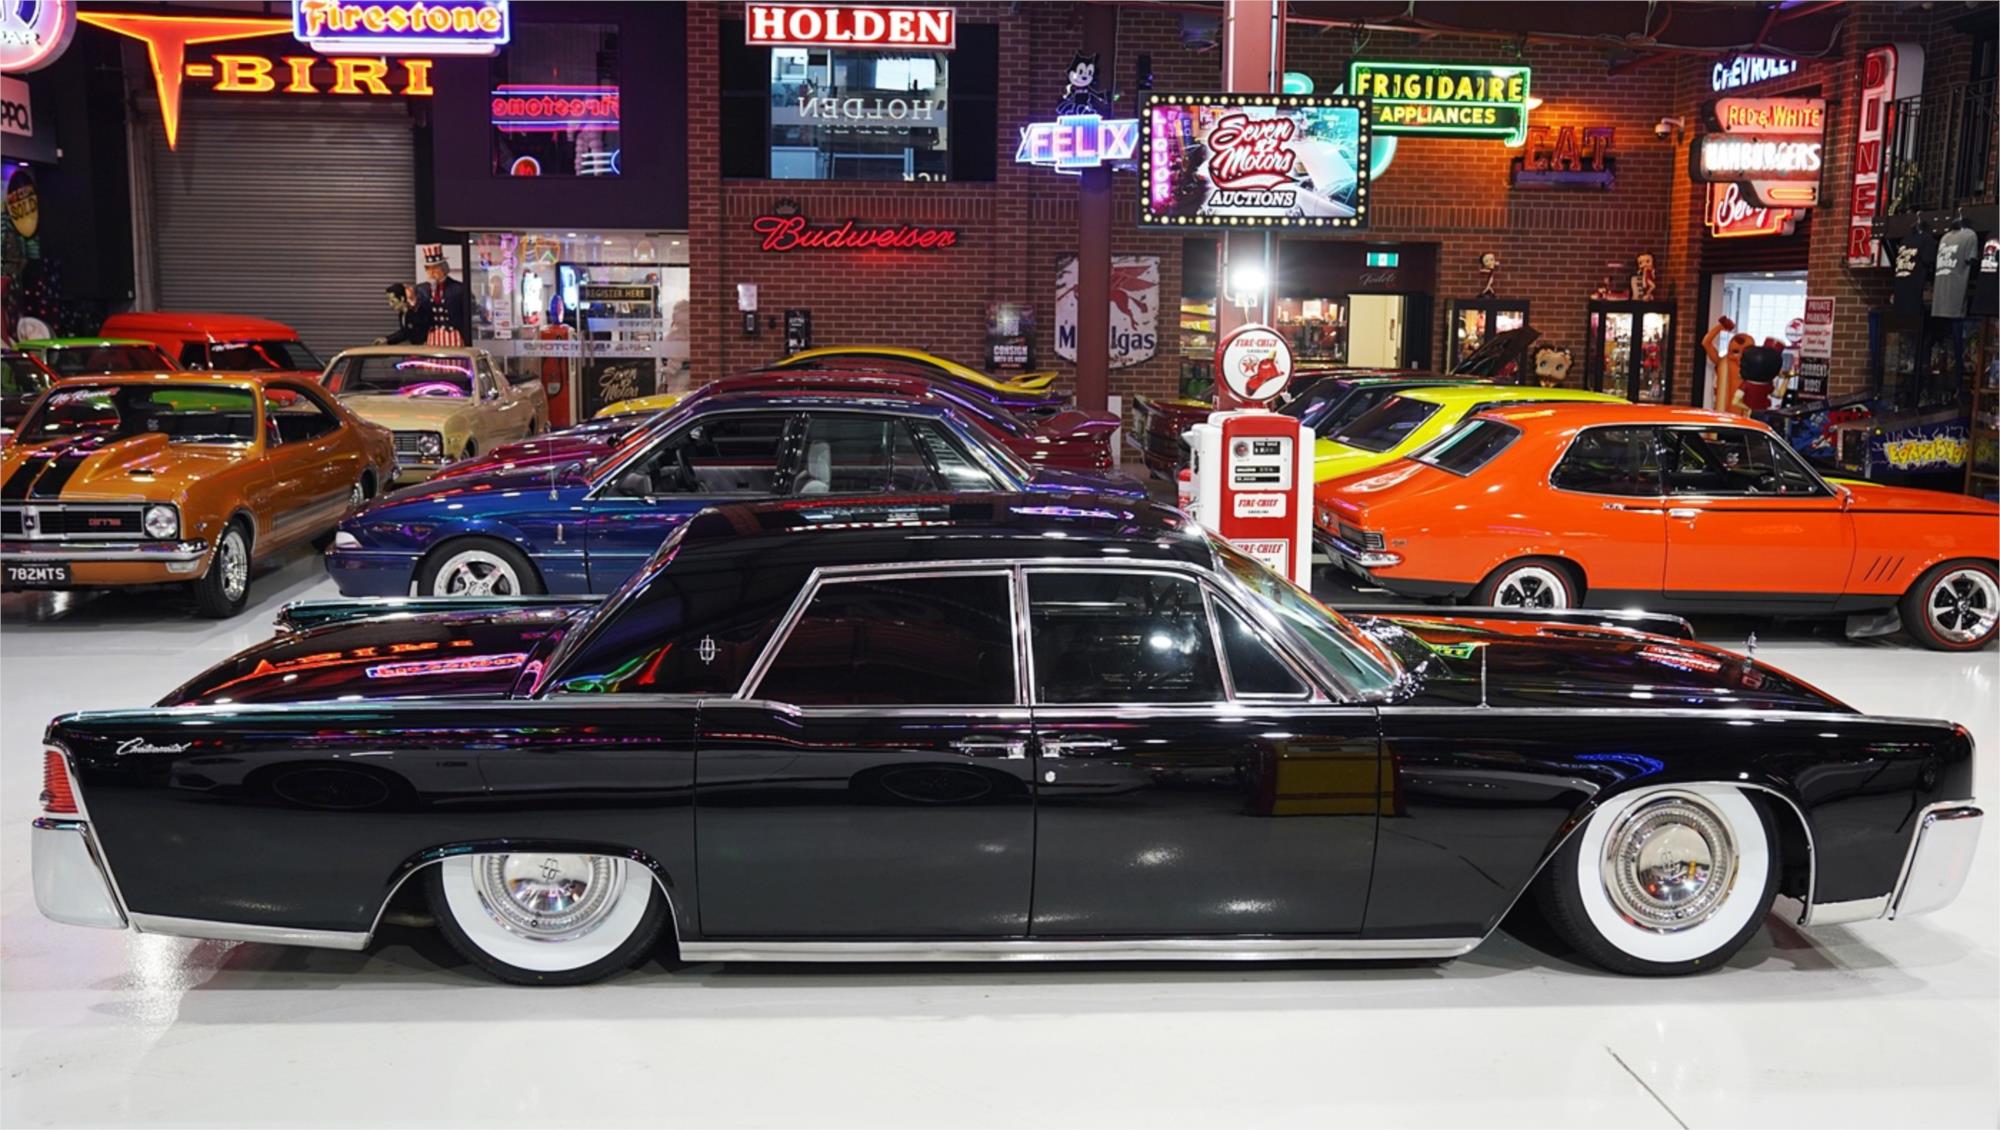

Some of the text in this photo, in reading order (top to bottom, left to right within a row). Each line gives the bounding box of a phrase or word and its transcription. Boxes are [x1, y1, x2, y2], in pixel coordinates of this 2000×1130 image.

[304, 2, 501, 33] Firestone
[752, 7, 949, 42] HOLDEN
[1356, 73, 1523, 101] FRIGIDAIRE
[1380, 107, 1496, 124] APPLIANCES
[1729, 105, 1757, 126] RED
[1772, 105, 1821, 126] WHITE
[1032, 124, 1131, 160] FELIX
[1211, 117, 1293, 151] Seven
[1523, 127, 1614, 171] EAT
[1152, 109, 1170, 202] LIQUOR
[1213, 145, 1292, 180] Motors
[1704, 142, 1822, 171] HAMBURGERS
[1850, 55, 1883, 258] DINER
[1209, 190, 1295, 207] AUCTIONS
[753, 216, 956, 251] Budweiser
[585, 289, 645, 298] REGISTER HERE
[1238, 499, 1278, 507] FIRE-CHIEF
[8, 567, 65, 580] 782MTS
